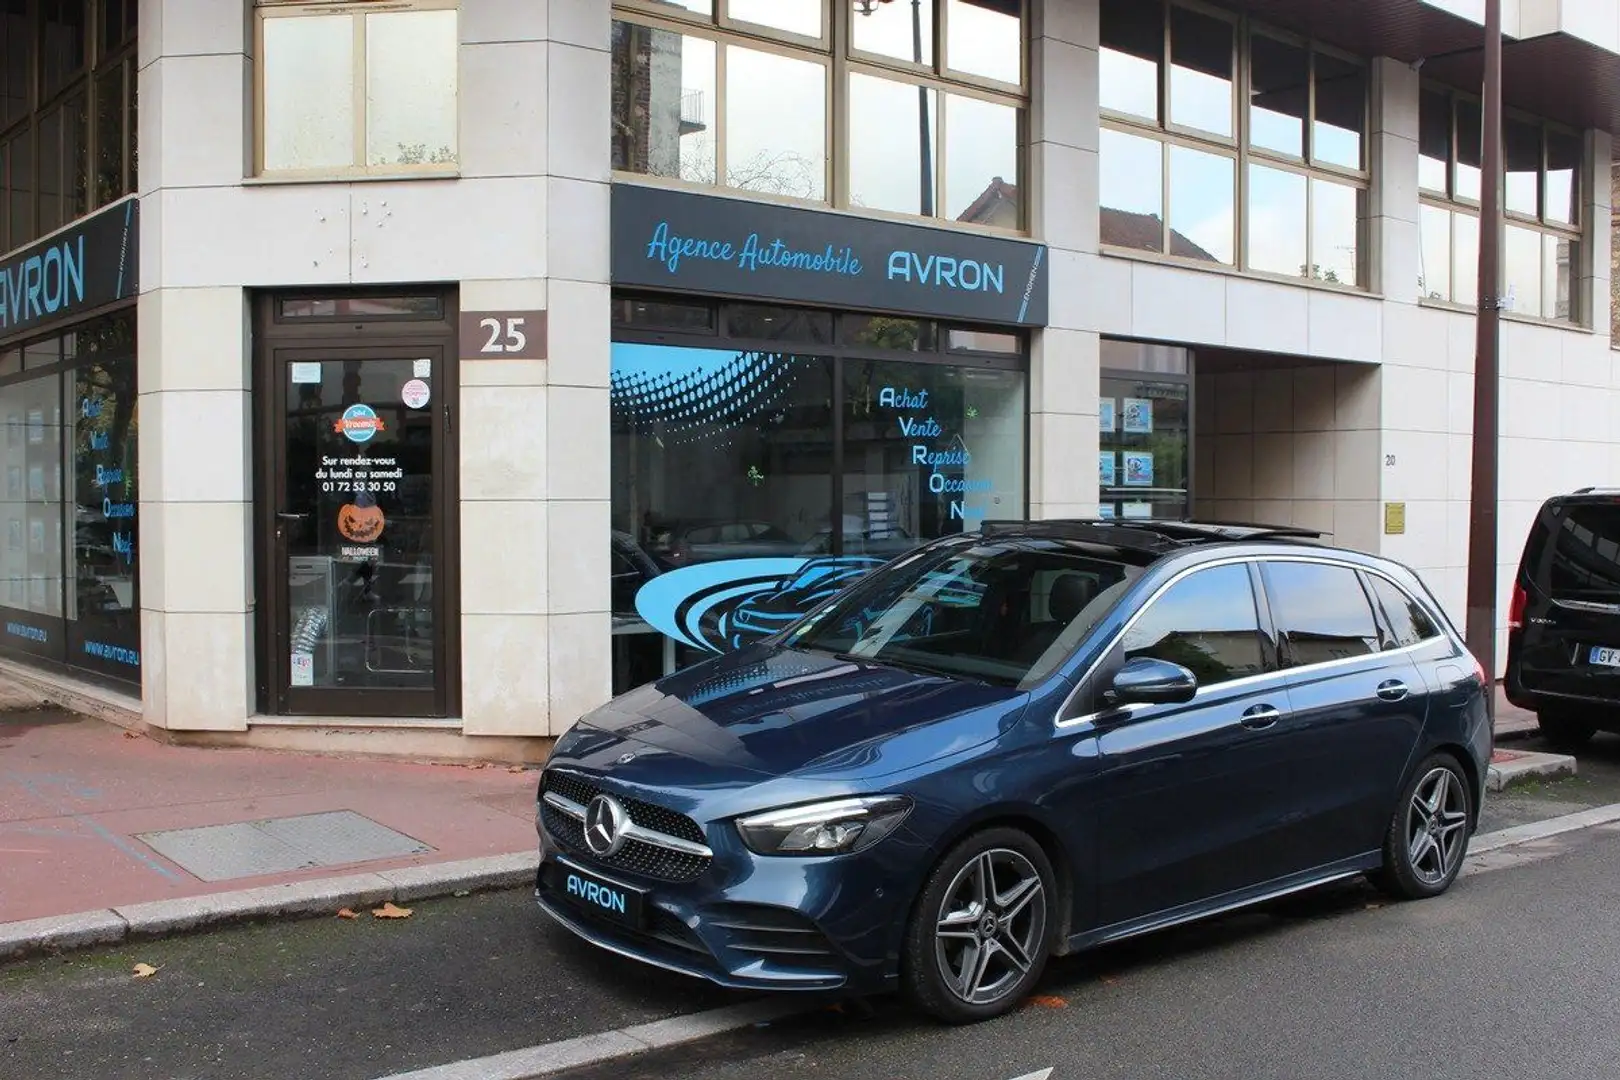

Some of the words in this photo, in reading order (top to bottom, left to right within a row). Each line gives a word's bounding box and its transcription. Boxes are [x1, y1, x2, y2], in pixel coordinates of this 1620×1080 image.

[647, 222, 736, 273] Agence
[738, 233, 864, 275] Automobile
[887, 250, 1004, 294] AVRON
[480, 317, 526, 353] 25
[879, 387, 929, 409] Achat
[898, 416, 942, 437] Vente
[322, 455, 339, 466] Sur
[340, 454, 396, 466] rendez-vous
[912, 445, 971, 473] Reprise
[1385, 454, 1396, 467] 20
[315, 467, 328, 479] du
[329, 467, 353, 479] lundi
[355, 470, 368, 479] au
[369, 467, 403, 479] samedi
[929, 473, 993, 493] Occa
[322, 481, 335, 493] 01
[337, 481, 351, 493] 72
[352, 481, 366, 493] 53
[367, 481, 381, 493] 30
[382, 481, 396, 493] 50
[84, 640, 140, 666] www.avron.eu
[1599, 649, 1620, 663] GV-
[566, 874, 625, 914] AVRON
